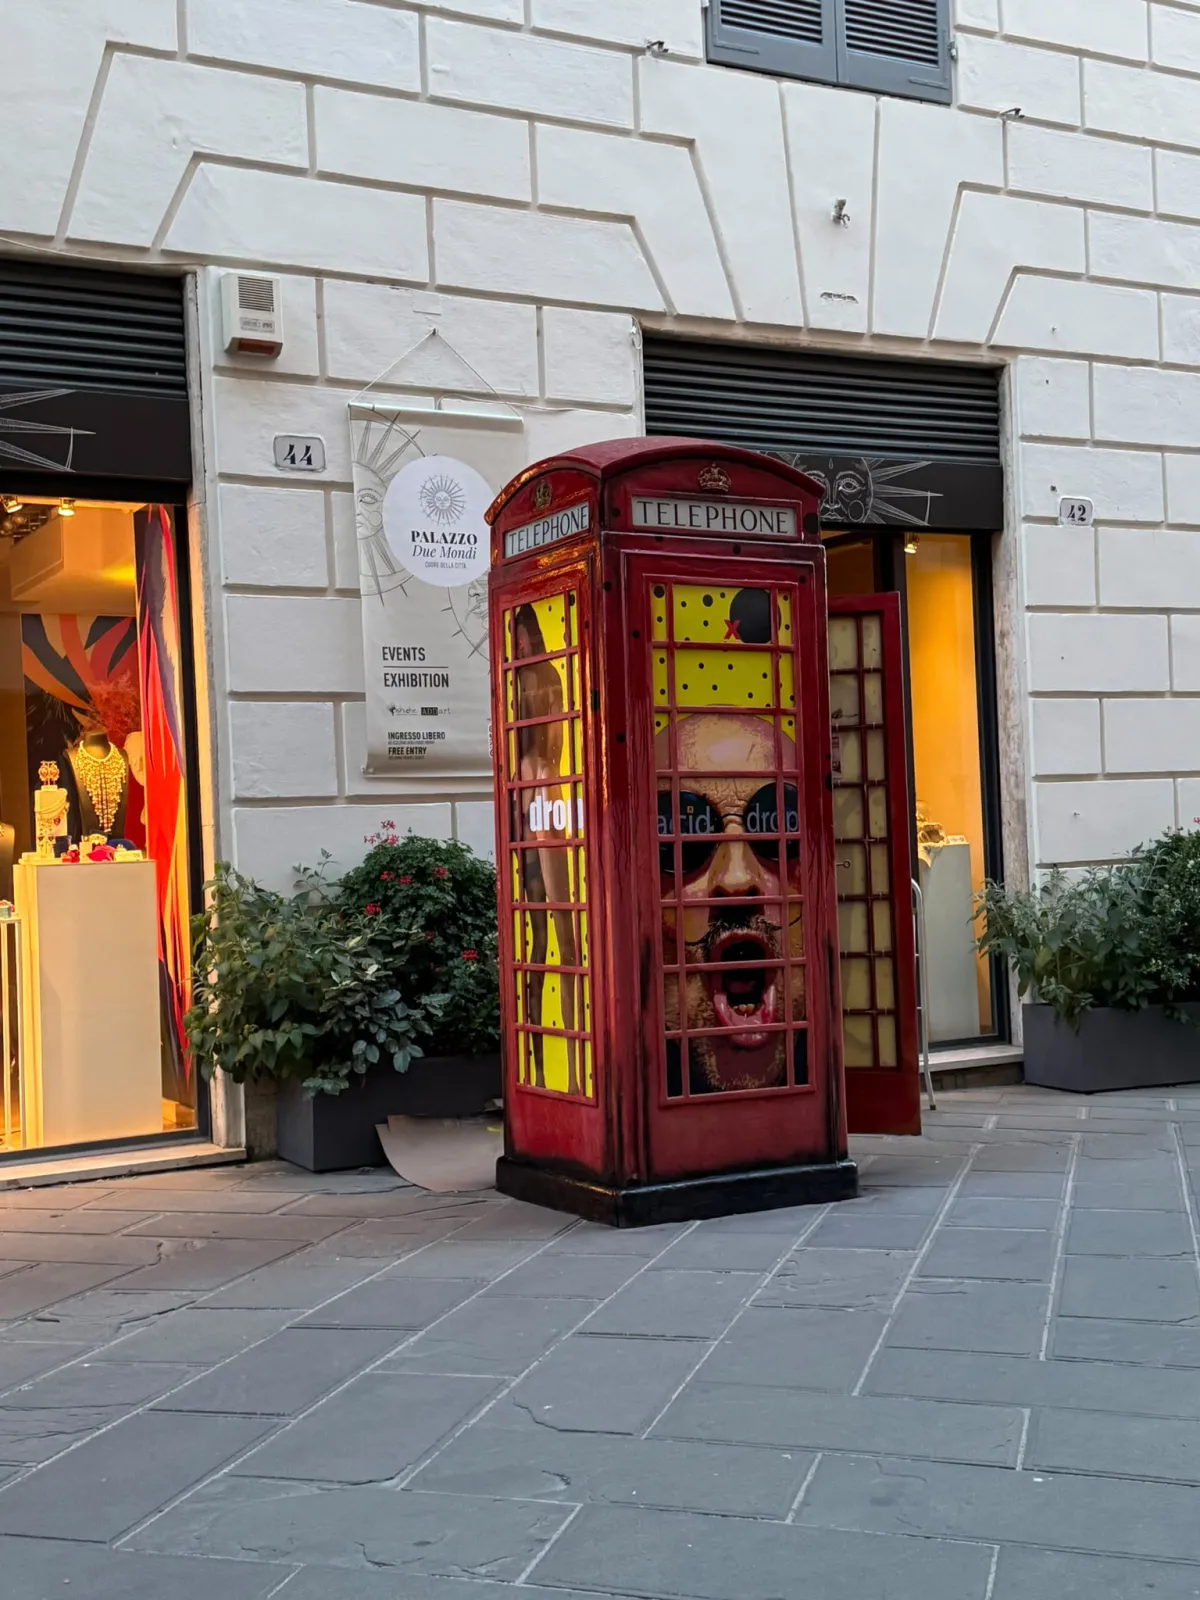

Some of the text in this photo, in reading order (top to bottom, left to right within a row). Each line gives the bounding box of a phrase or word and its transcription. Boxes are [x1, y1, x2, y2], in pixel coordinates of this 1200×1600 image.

[283, 443, 313, 466] 44
[637, 501, 789, 534] TELEPHONE
[1067, 504, 1087, 522] 42
[509, 505, 588, 554] TELEPHONE
[411, 530, 478, 545] PALAZZO
[412, 545, 477, 559] Due Mondi
[382, 646, 426, 661] EVENTS
[383, 672, 449, 688] EXHIBITION
[388, 732, 446, 740] INGRESSO LIBERO
[388, 746, 427, 755] FREE ENTRY
